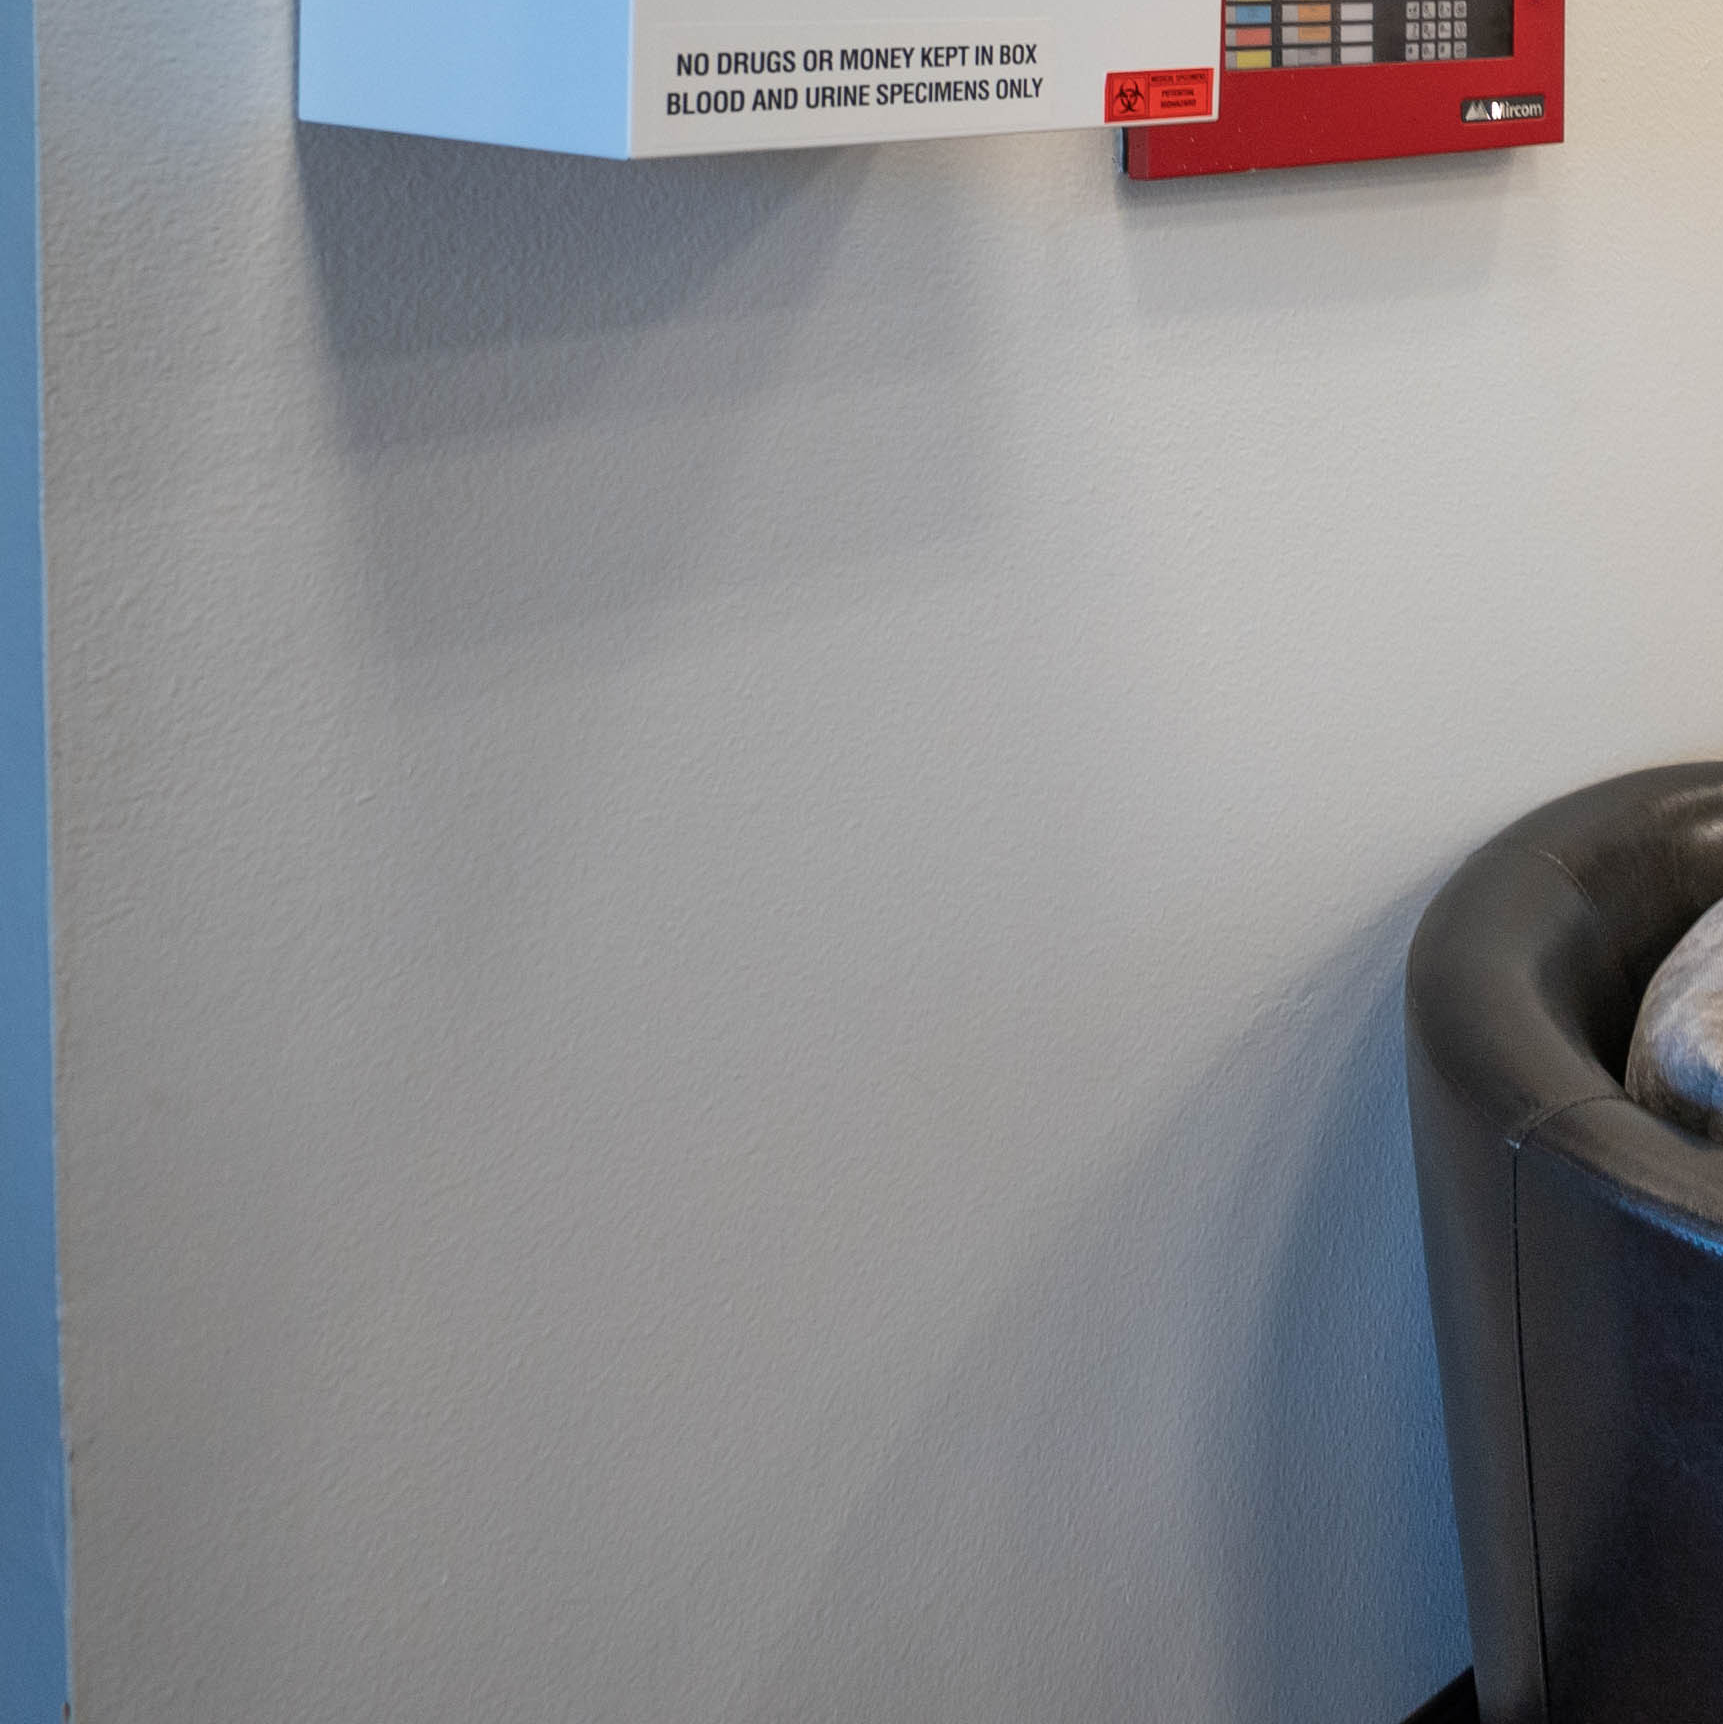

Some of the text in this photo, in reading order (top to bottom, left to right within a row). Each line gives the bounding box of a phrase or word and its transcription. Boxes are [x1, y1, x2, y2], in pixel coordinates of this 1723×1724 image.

[676, 44, 1037, 76] NO DRUGS OR MONEY KEPT IN BOX
[666, 77, 1043, 116] BLOOD AND URINE SPECIMENS ONLY
[1490, 100, 1543, 120] Mircom
